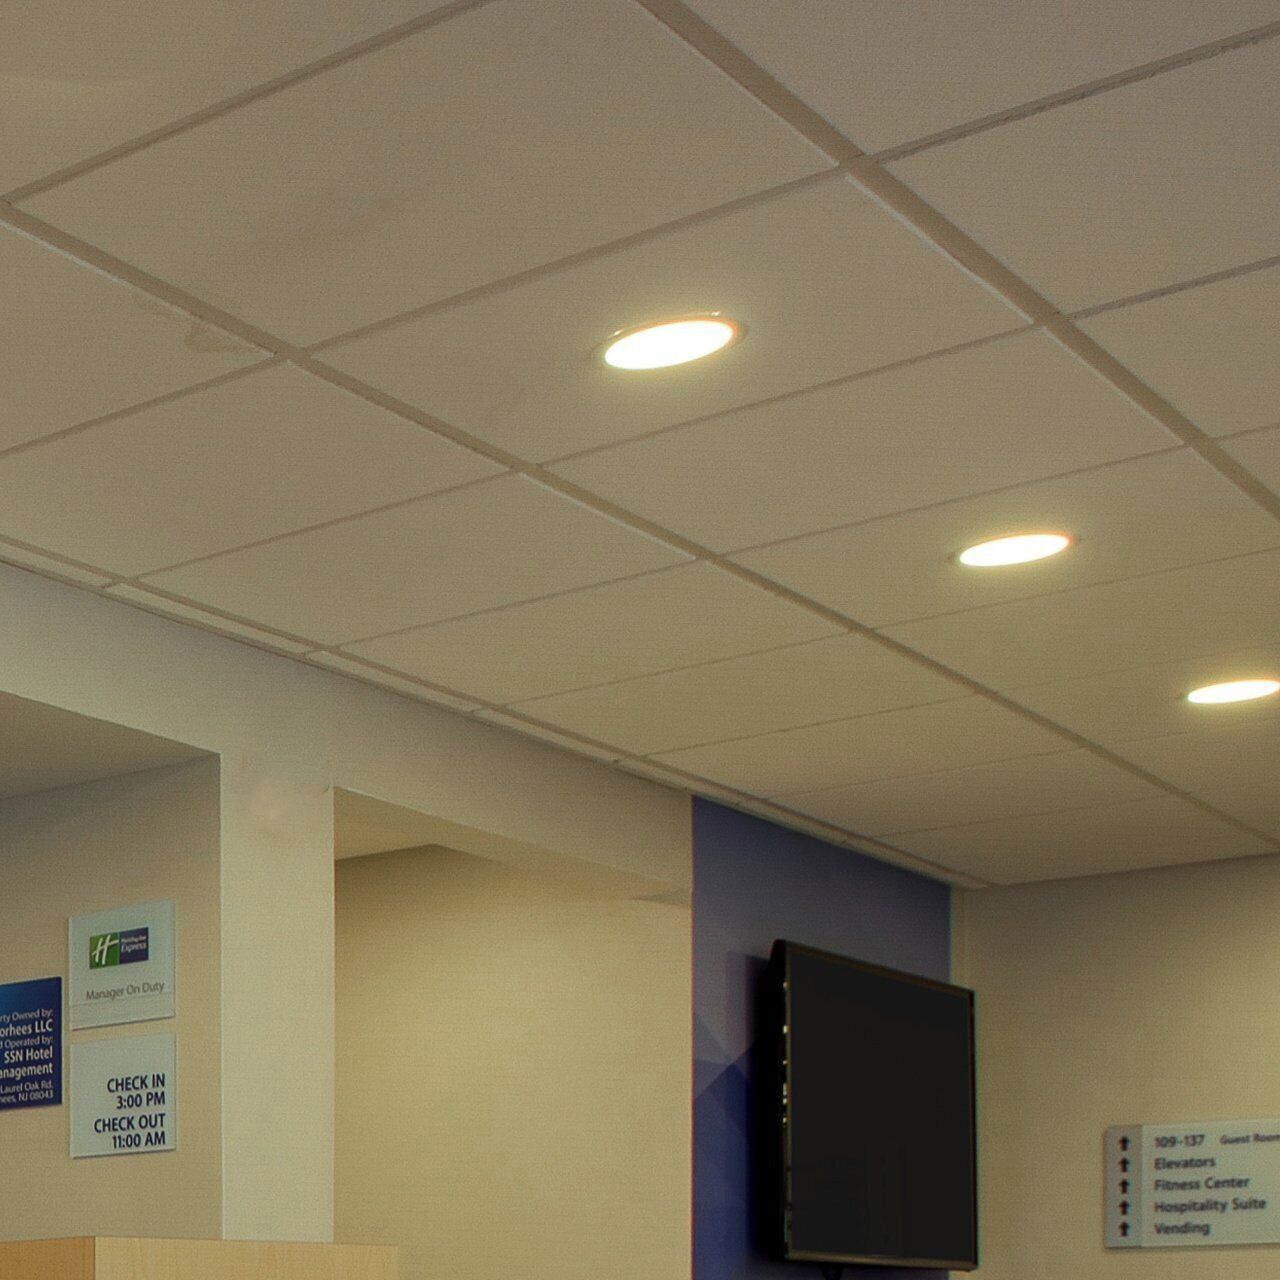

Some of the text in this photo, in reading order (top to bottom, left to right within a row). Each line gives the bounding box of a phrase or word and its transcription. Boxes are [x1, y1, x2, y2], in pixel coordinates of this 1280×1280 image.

[121, 943, 147, 953] Express
[86, 982, 165, 1002] Manager On Duty
[12, 1010, 40, 1020] Owned
[41, 1008, 54, 1019] by:
[35, 1019, 53, 1033] LLC
[4, 1036, 40, 1050] Operated
[41, 1036, 54, 1046] by:
[4, 1045, 53, 1063] SSN Hotel
[0, 1082, 23, 1095] Laurel
[24, 1080, 39, 1090] Oak
[107, 1073, 165, 1093] CHECK IN
[18, 1092, 28, 1101] NJ
[29, 1089, 54, 1099] 08043
[116, 1091, 165, 1109] 3:00 PM
[94, 1113, 165, 1133] CHECK OUT
[112, 1131, 165, 1149] 11:00 AM
[1220, 1135, 1250, 1144] Guest
[1154, 1158, 1216, 1170] Elevators
[1154, 1177, 1250, 1190] Fitness Center
[1154, 1198, 1266, 1214] Hospitality Suite
[1154, 1222, 1210, 1236] Vending
